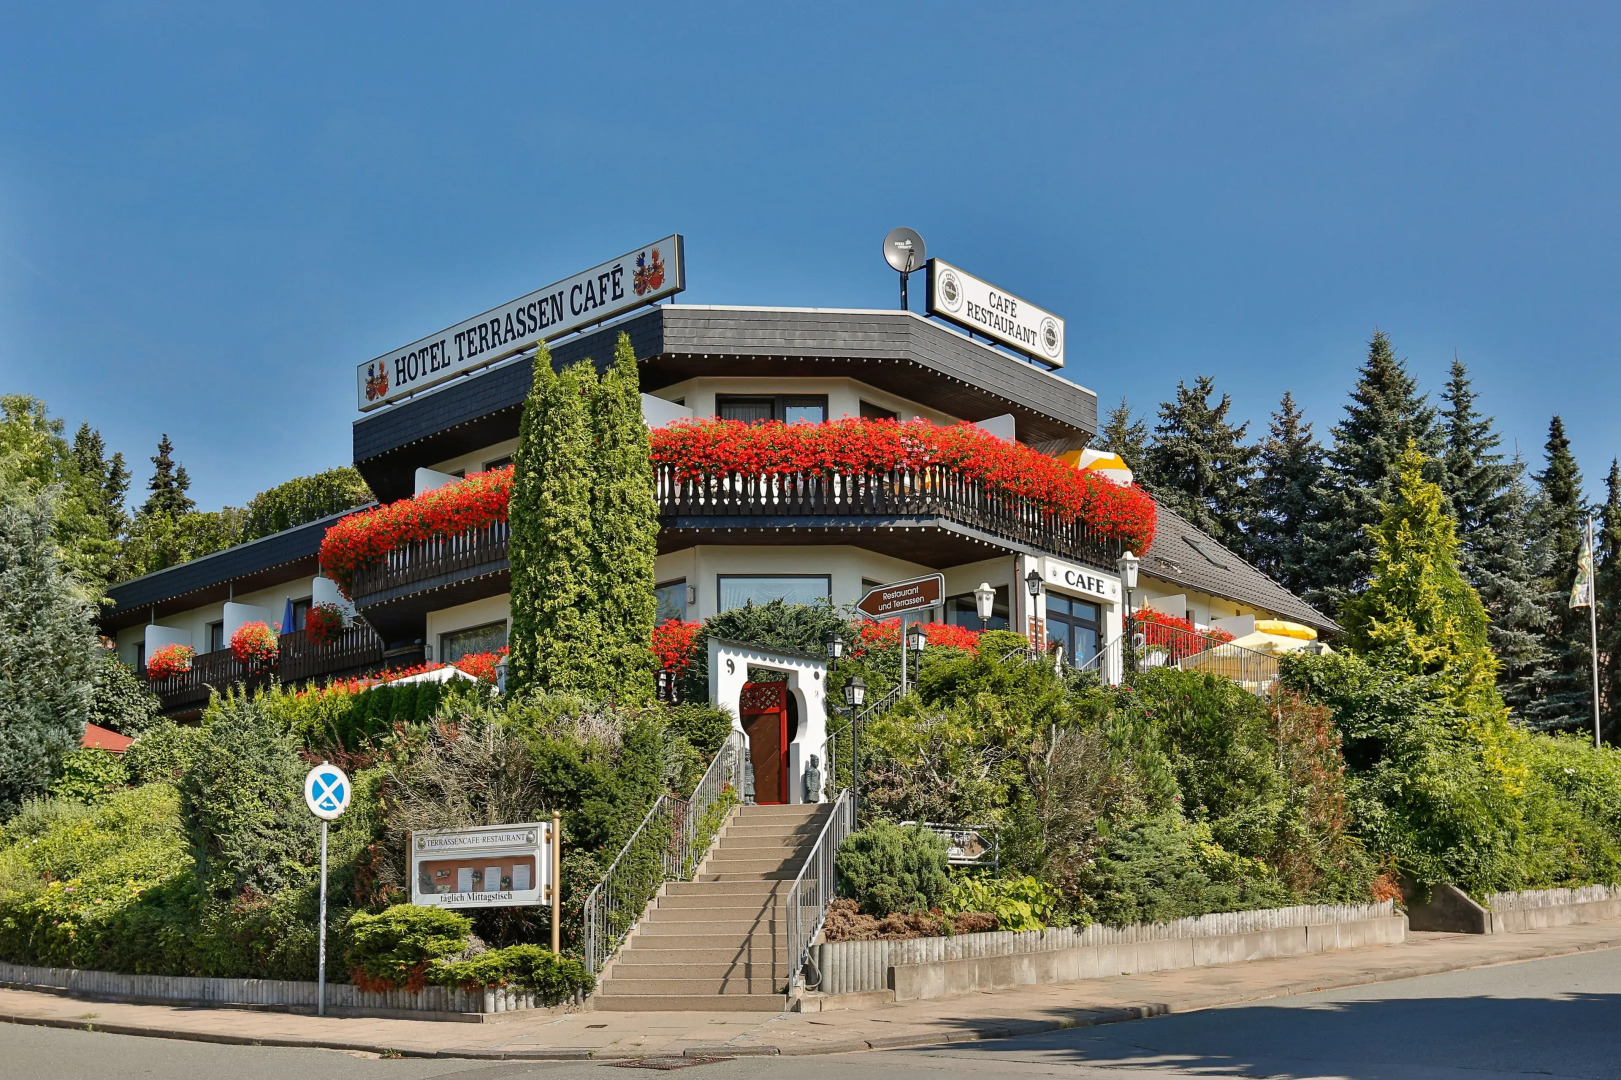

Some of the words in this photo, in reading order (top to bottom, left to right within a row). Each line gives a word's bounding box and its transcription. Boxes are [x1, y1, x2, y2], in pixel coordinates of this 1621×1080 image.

[988, 291, 1018, 318] CAFÉ
[395, 339, 451, 387] HOTEL
[454, 290, 564, 362] TERRASSEN
[569, 263, 624, 317] CAFÉ
[966, 300, 1038, 347] RESTAURANT
[882, 585, 919, 601] Restaurant
[1064, 570, 1105, 595] CAFE
[878, 601, 892, 611] und
[893, 595, 925, 609] Terrassen
[467, 891, 513, 903] Mittagstisch
